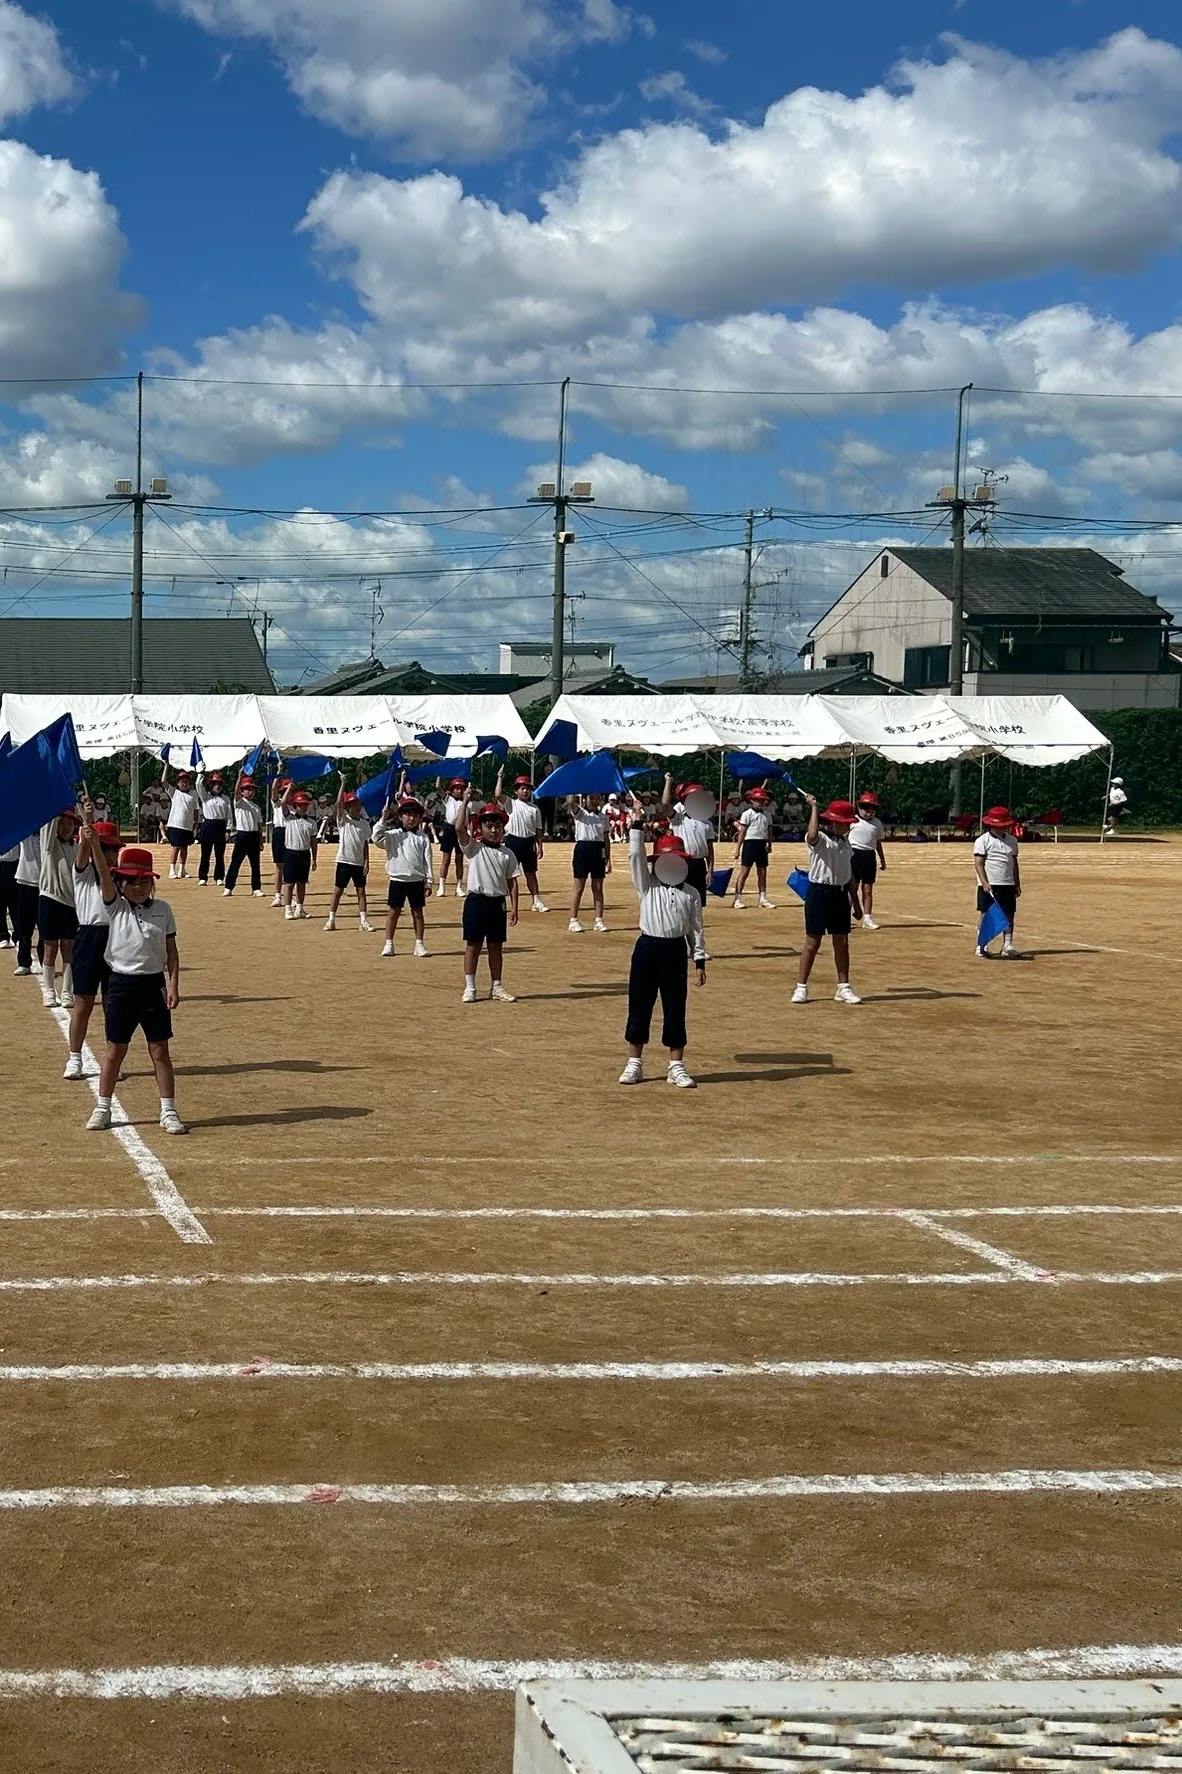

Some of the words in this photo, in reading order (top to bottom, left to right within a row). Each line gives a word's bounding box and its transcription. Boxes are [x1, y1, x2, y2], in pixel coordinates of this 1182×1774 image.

[75, 715, 205, 735] 里ヌヴェール学院小学校
